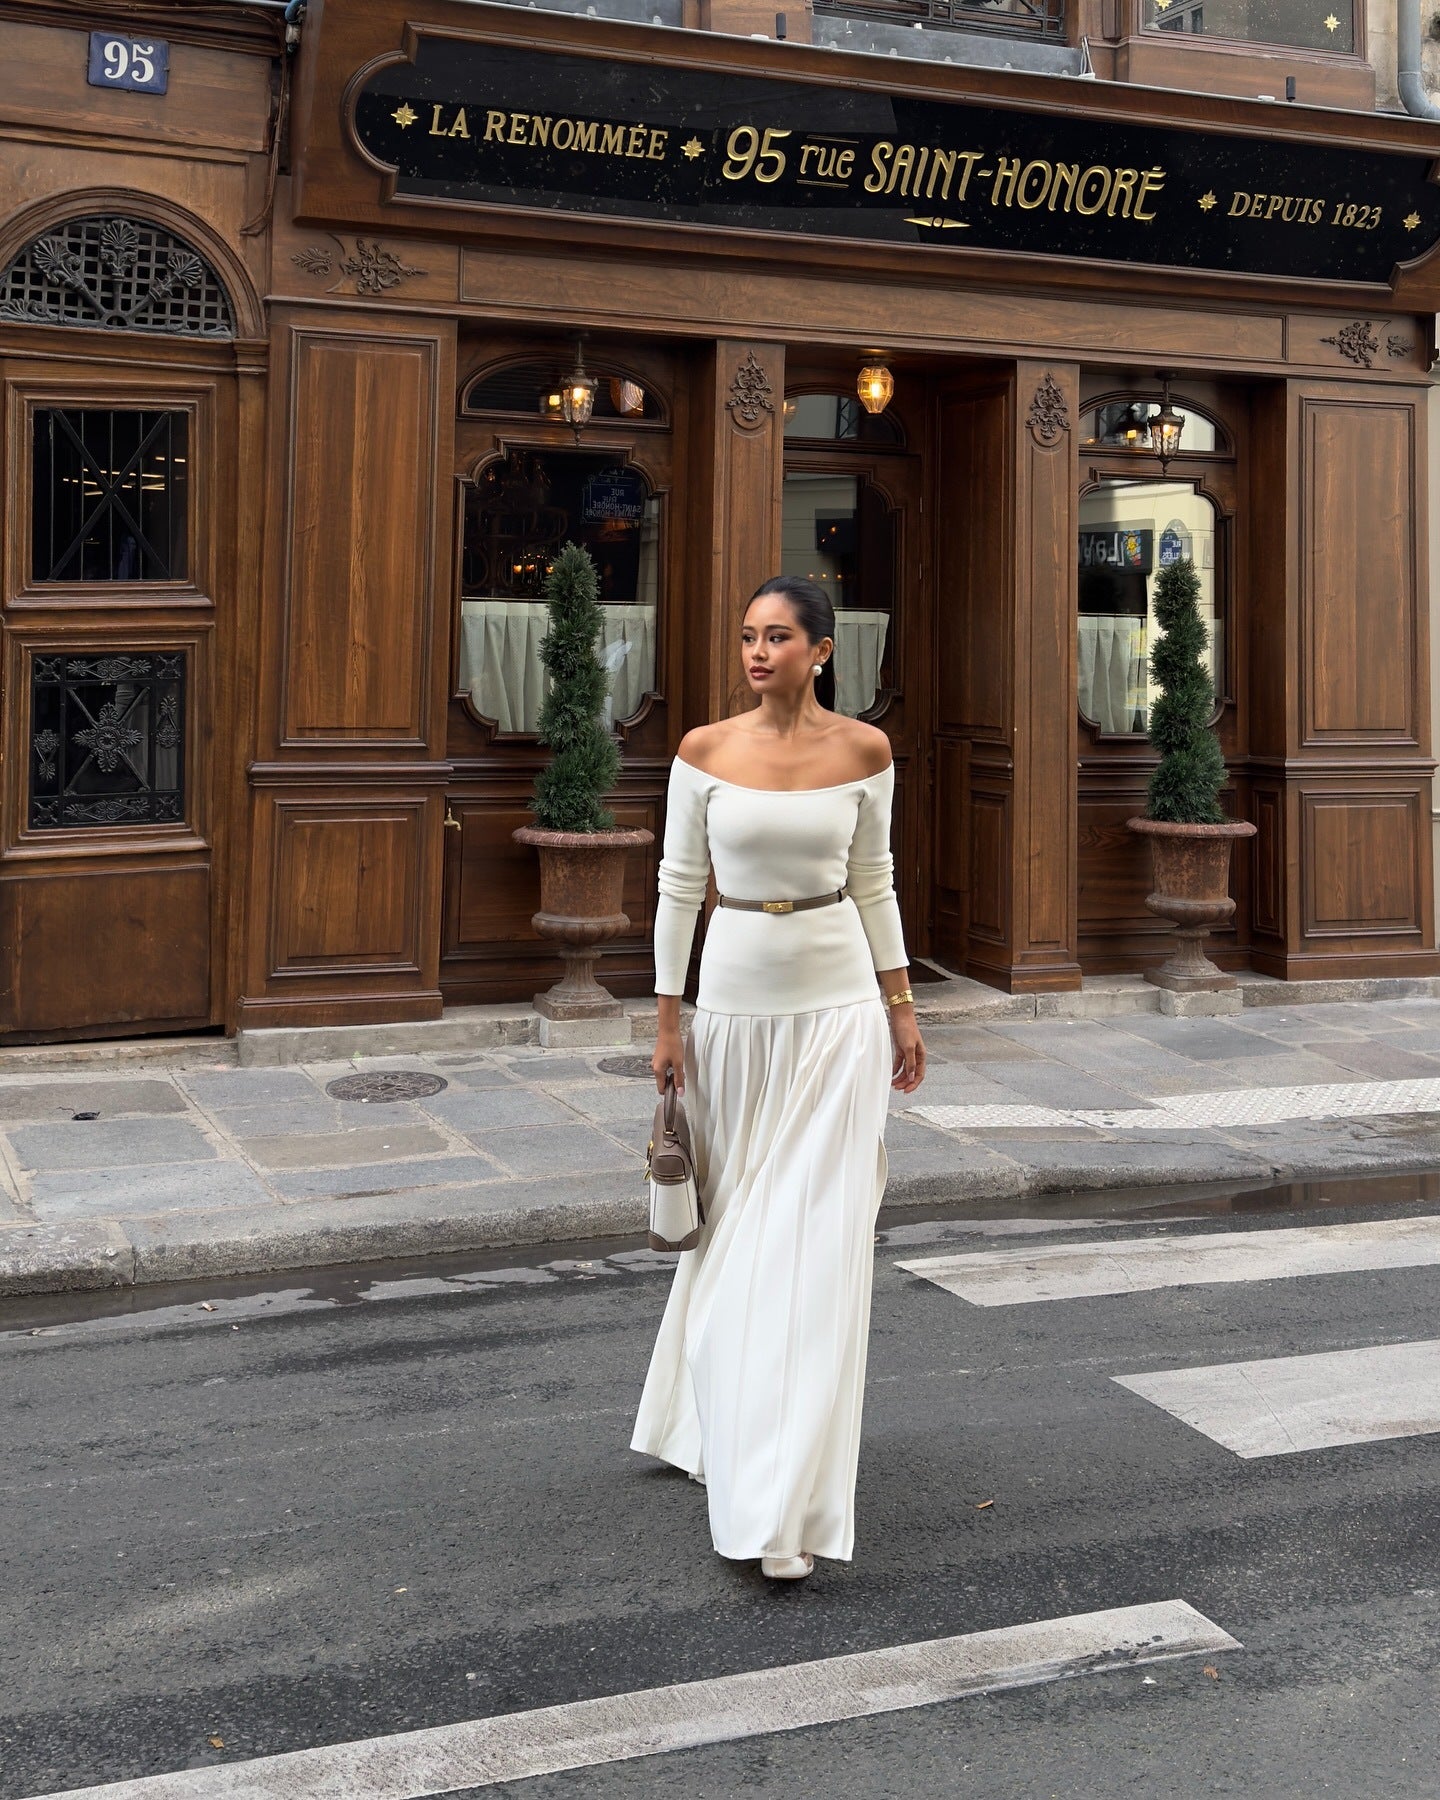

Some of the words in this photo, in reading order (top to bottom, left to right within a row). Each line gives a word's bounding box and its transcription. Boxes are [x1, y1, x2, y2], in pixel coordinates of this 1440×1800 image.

[104, 41, 154, 83] 95
[428, 104, 471, 139] LA
[483, 111, 668, 161] RENOMMÉE
[721, 125, 792, 183] 95
[799, 144, 856, 179] rue
[863, 141, 1167, 221] SAINT-HONORÉ
[1228, 191, 1326, 224] DEPUIS
[1331, 203, 1382, 229] 1823
